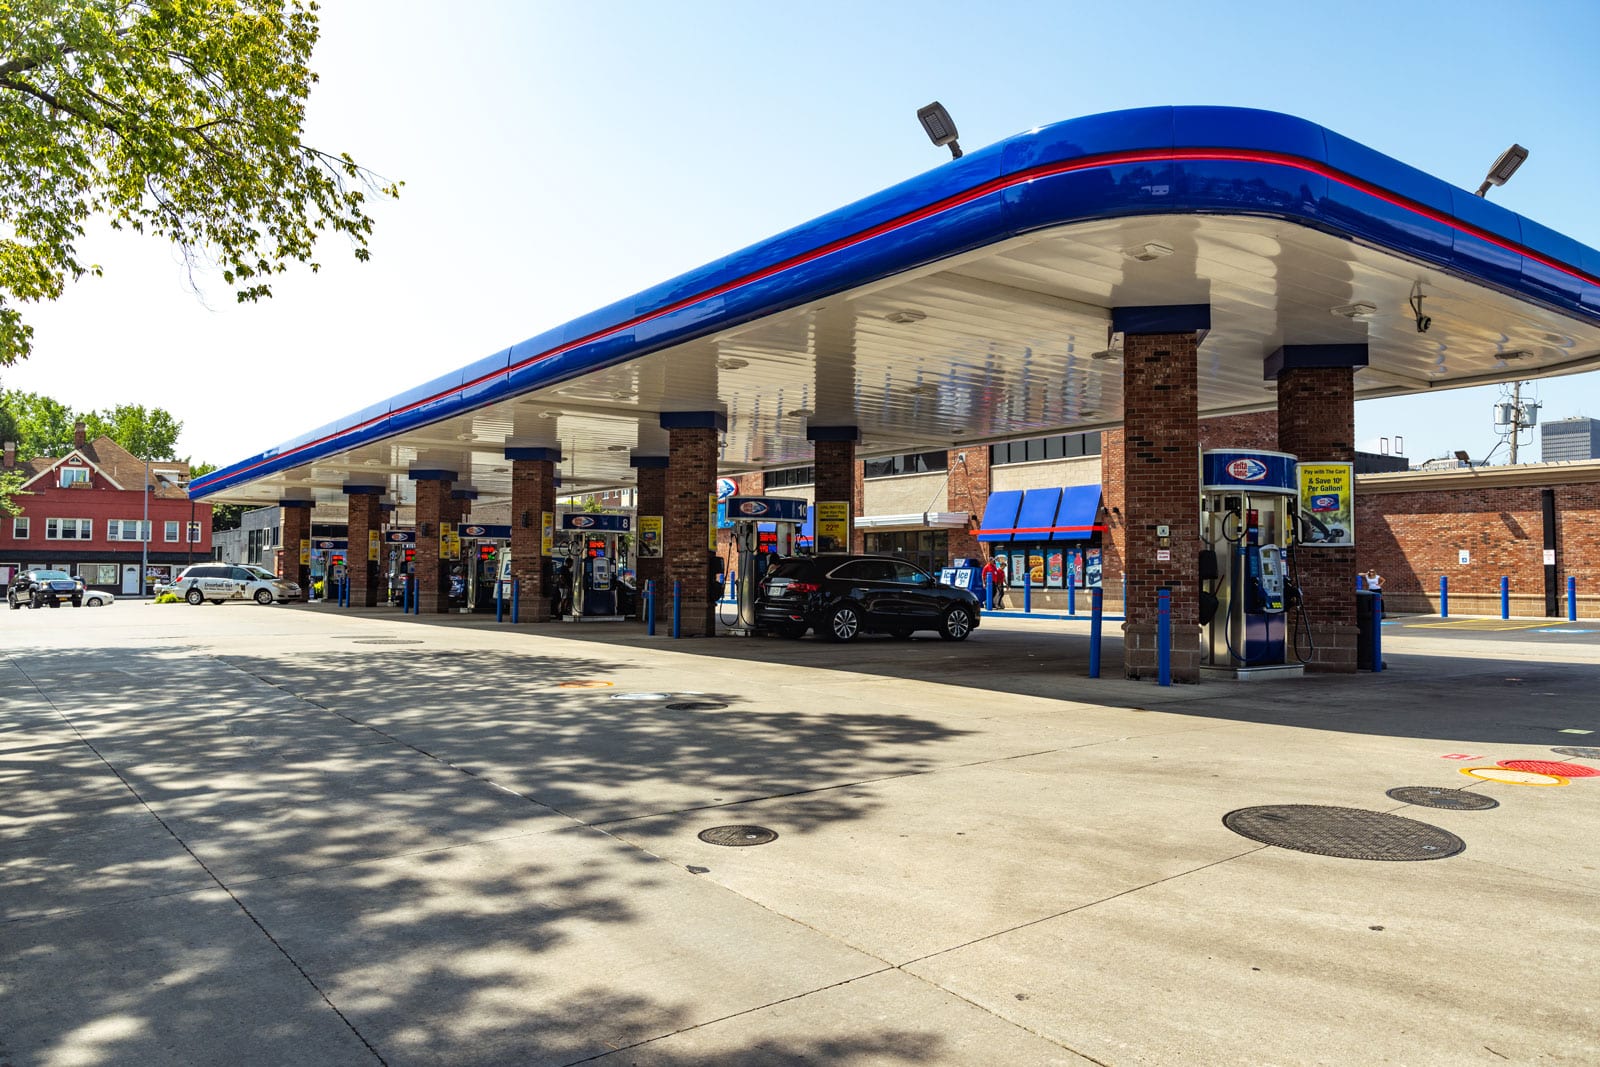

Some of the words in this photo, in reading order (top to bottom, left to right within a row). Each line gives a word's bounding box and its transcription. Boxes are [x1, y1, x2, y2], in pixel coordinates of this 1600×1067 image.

[798, 503, 807, 517] 10
[622, 518, 628, 528] 8
[957, 570, 969, 579] ice
